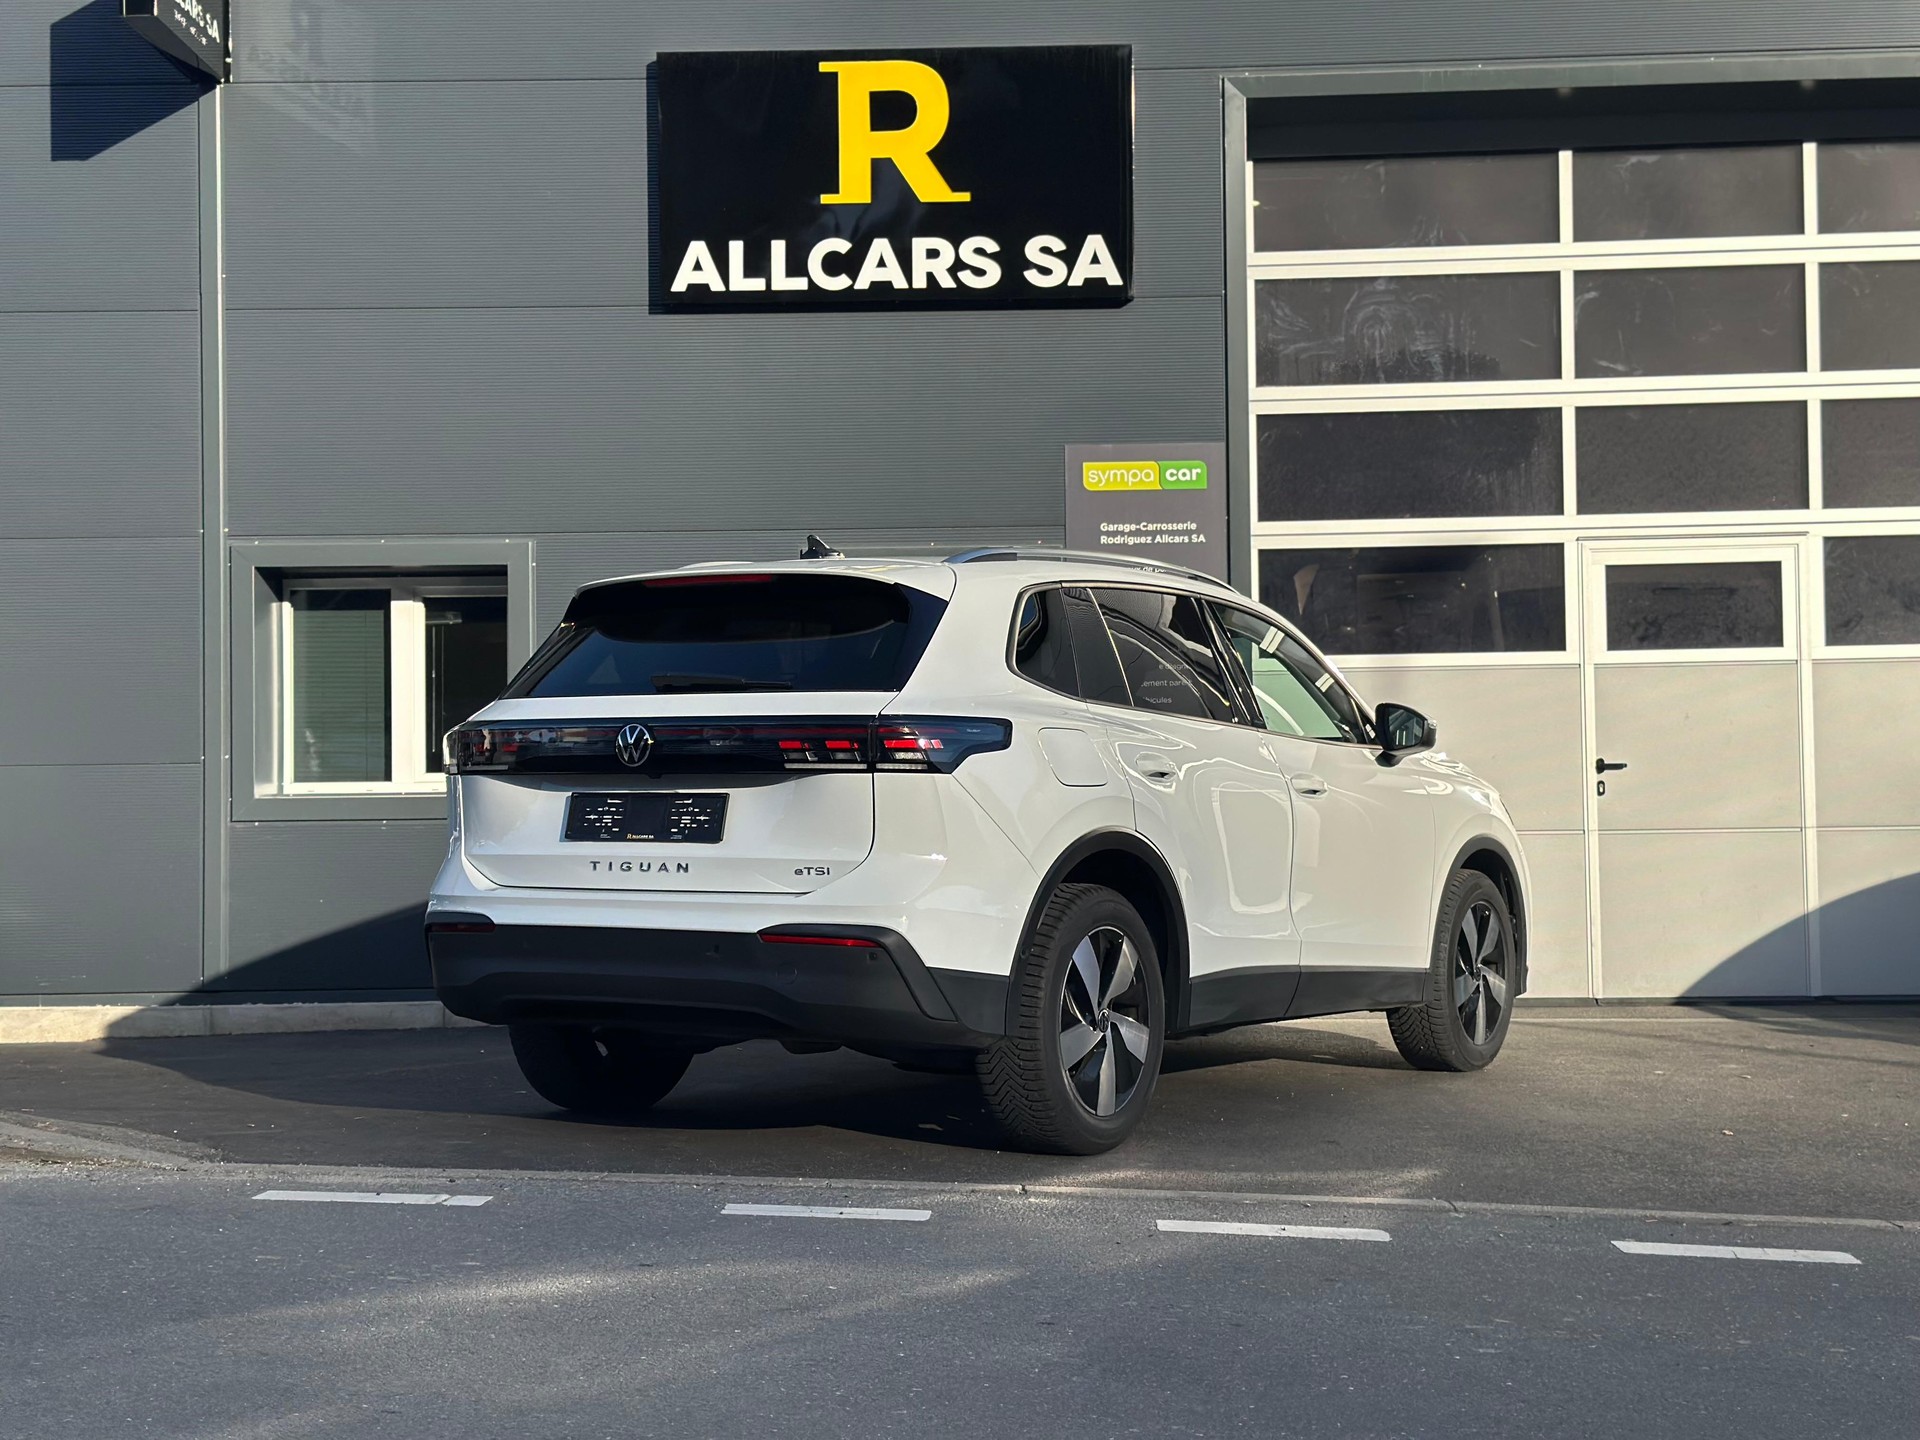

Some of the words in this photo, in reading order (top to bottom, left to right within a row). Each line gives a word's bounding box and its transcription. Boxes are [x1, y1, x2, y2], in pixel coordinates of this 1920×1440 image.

[206, 13, 220, 43] SA
[818, 59, 971, 205] R
[670, 237, 1002, 292] ALLCARS
[1022, 234, 1124, 288] SA
[1088, 468, 1155, 487] sympa
[1165, 467, 1202, 481] car
[1100, 521, 1197, 532] Garage-Carrosserie
[1100, 535, 1152, 545] Rodriguez
[1154, 535, 1189, 543] Allcars
[1191, 534, 1206, 543] SA
[590, 861, 689, 873] TIGUAN
[794, 867, 831, 876] eTSI
